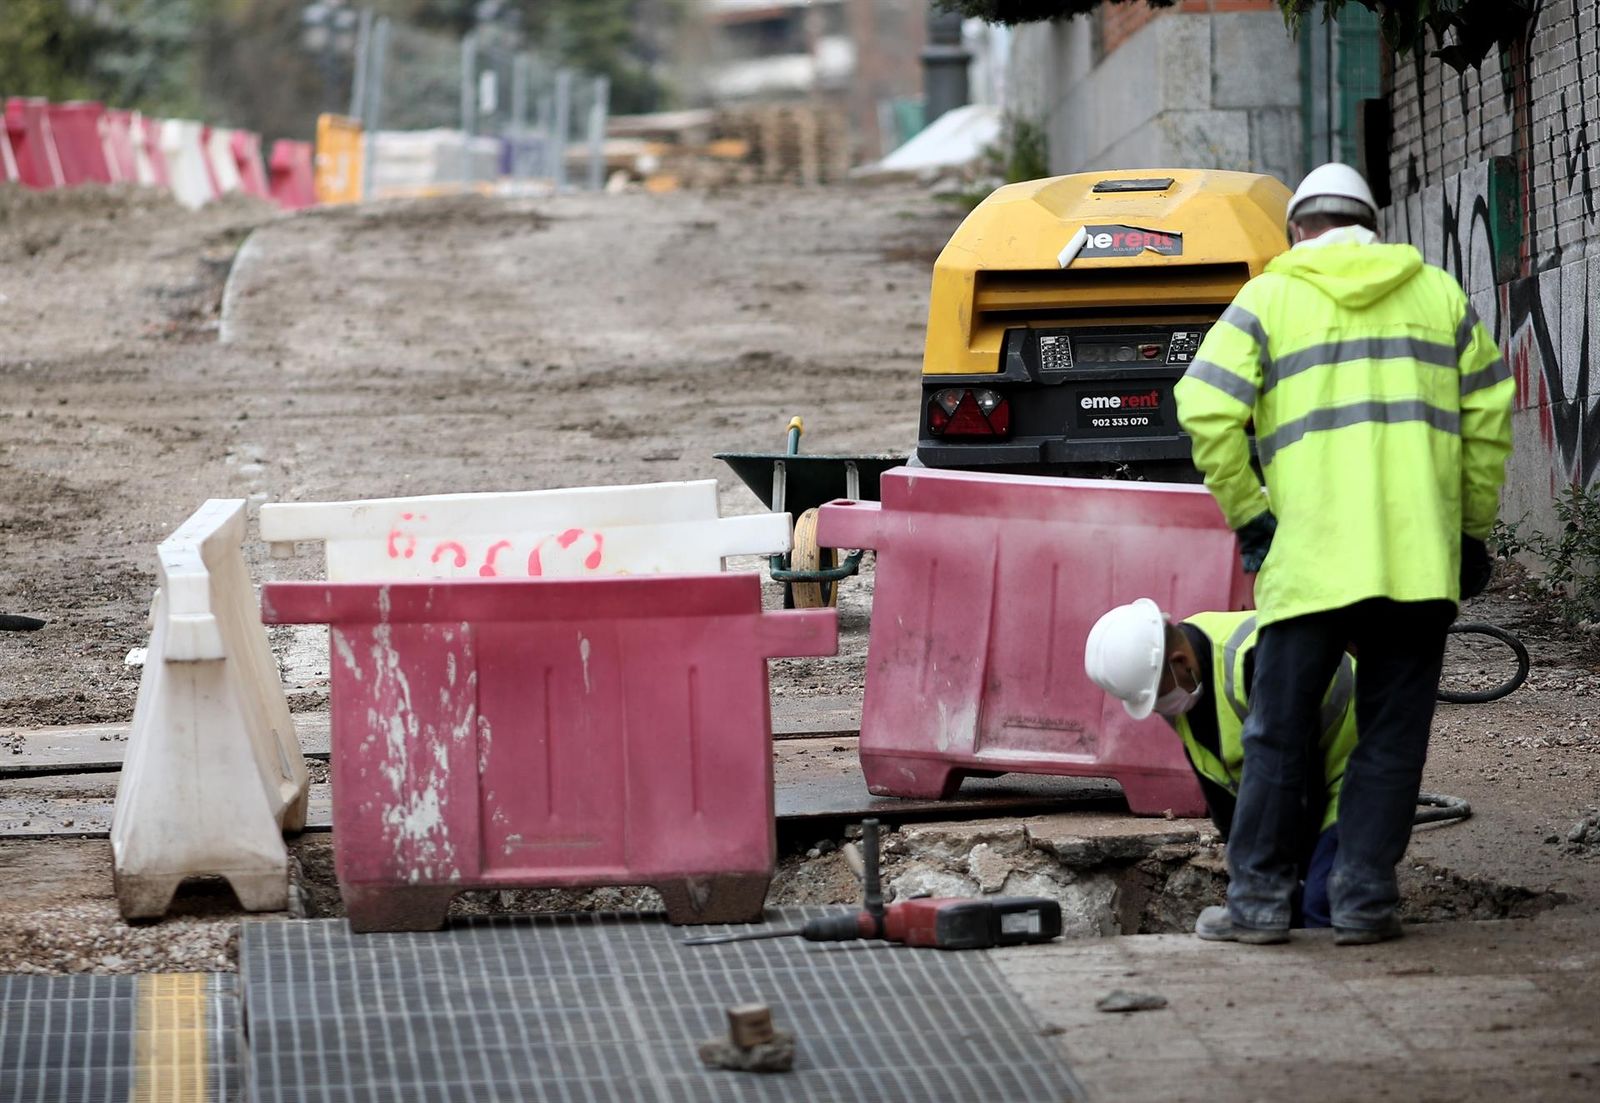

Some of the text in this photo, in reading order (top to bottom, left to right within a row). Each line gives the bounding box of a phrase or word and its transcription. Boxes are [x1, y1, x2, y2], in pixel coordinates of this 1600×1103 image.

[1080, 390, 1159, 409] emerent
[1092, 417, 1149, 427] 902 333 070
